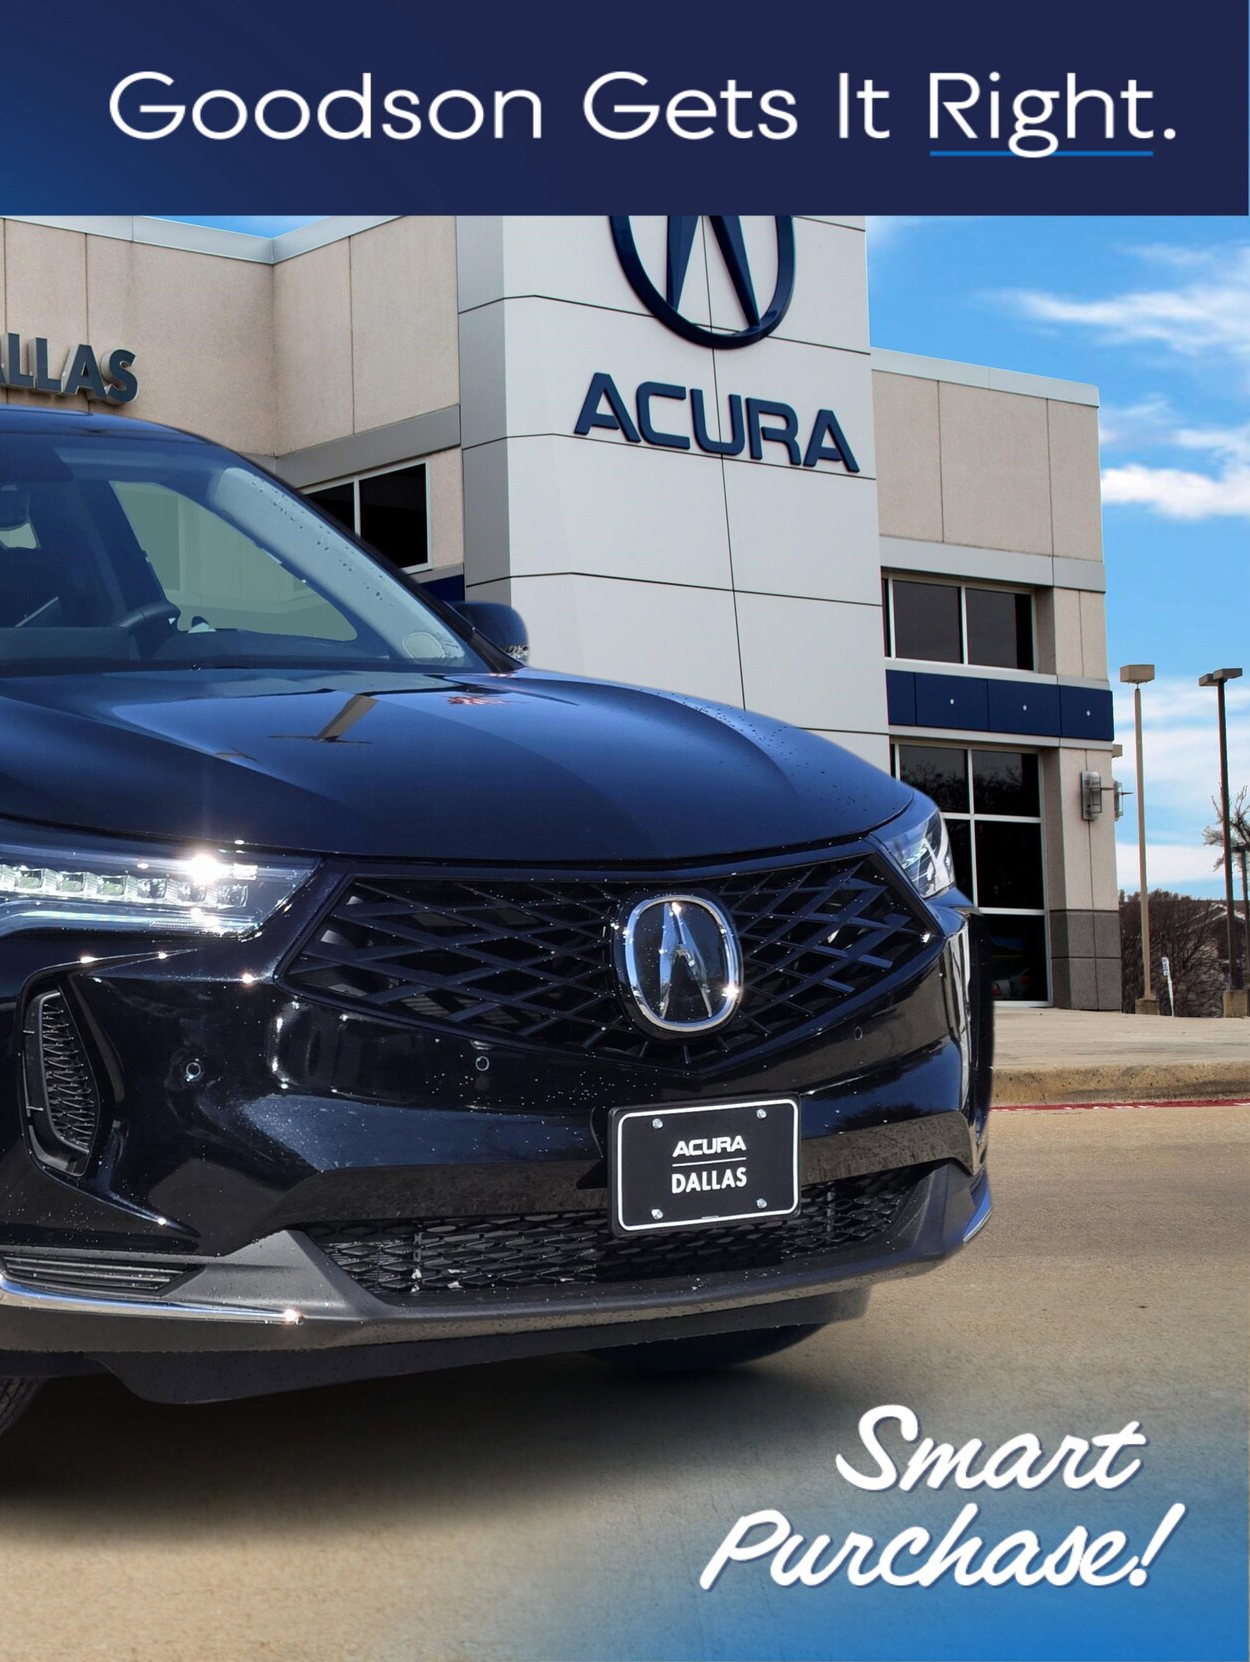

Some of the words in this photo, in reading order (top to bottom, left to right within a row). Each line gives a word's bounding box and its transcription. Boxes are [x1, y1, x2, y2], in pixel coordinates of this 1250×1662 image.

[574, 372, 860, 473] ACURA
[672, 1135, 747, 1157] ACURA
[671, 1166, 747, 1194] DALLAS
